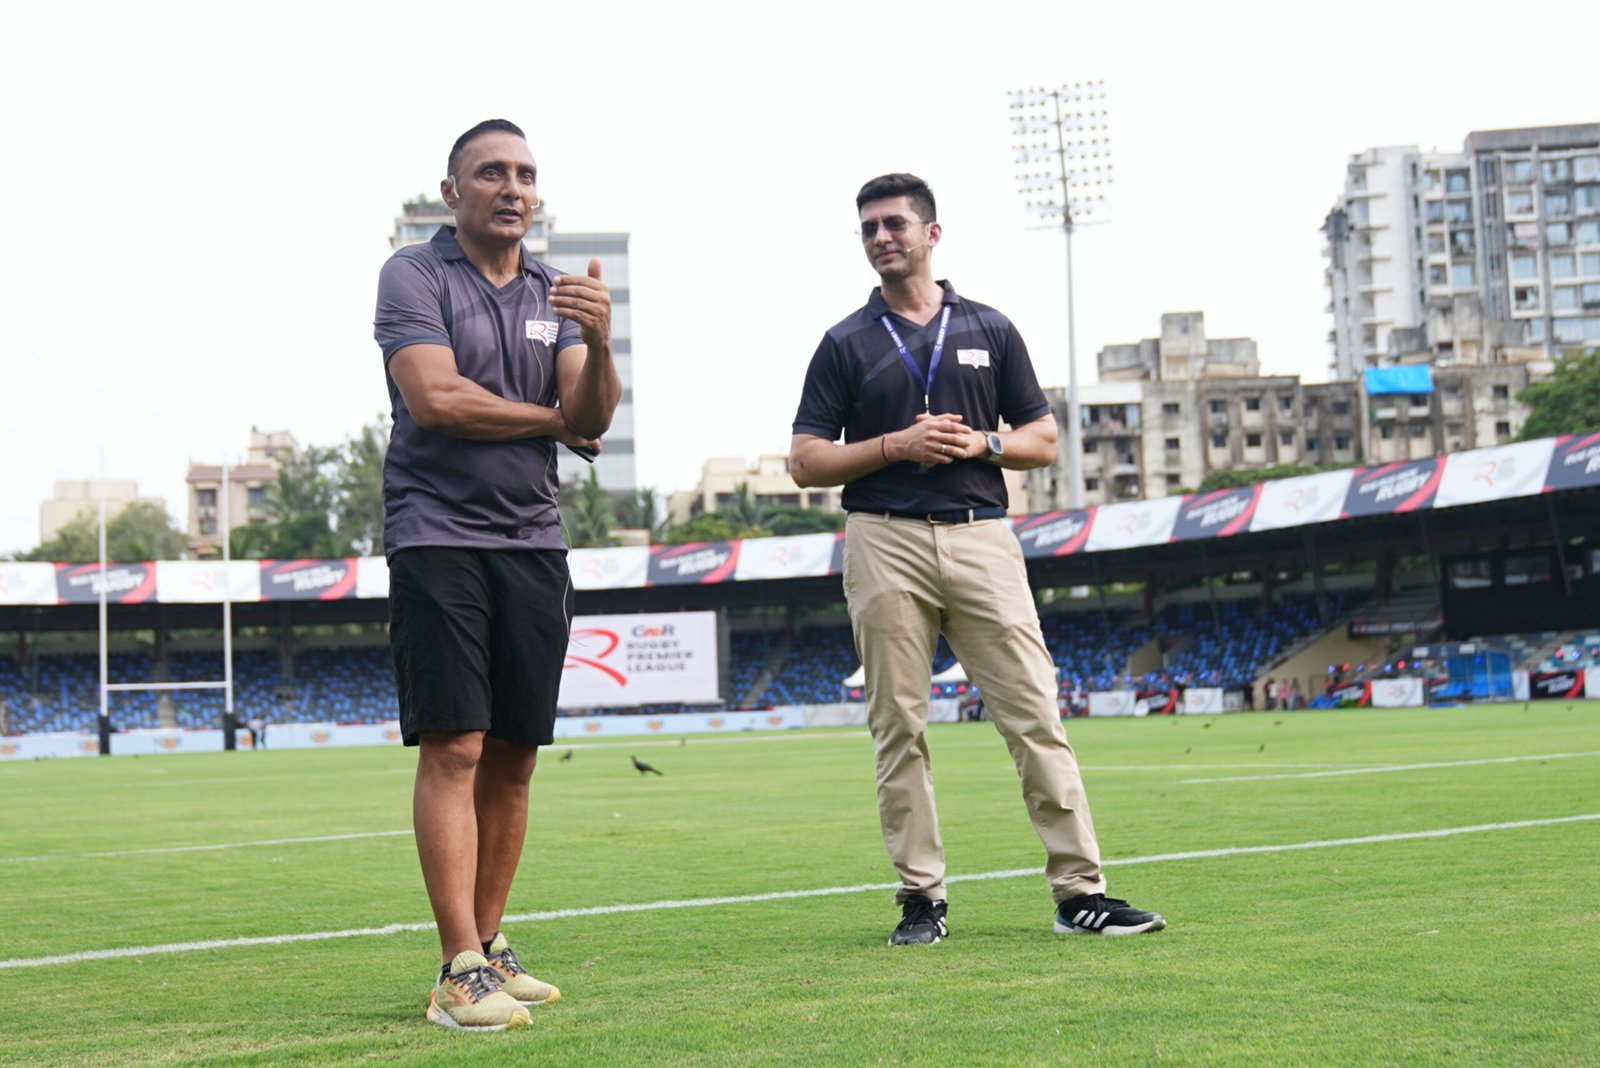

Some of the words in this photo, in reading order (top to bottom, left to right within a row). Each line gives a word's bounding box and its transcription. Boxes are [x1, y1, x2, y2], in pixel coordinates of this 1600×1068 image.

[1374, 471, 1432, 503] RUGBY
[627, 640, 680, 649] RUGBY
[627, 651, 694, 660] PREMIER
[627, 663, 687, 672] LEAGUE
